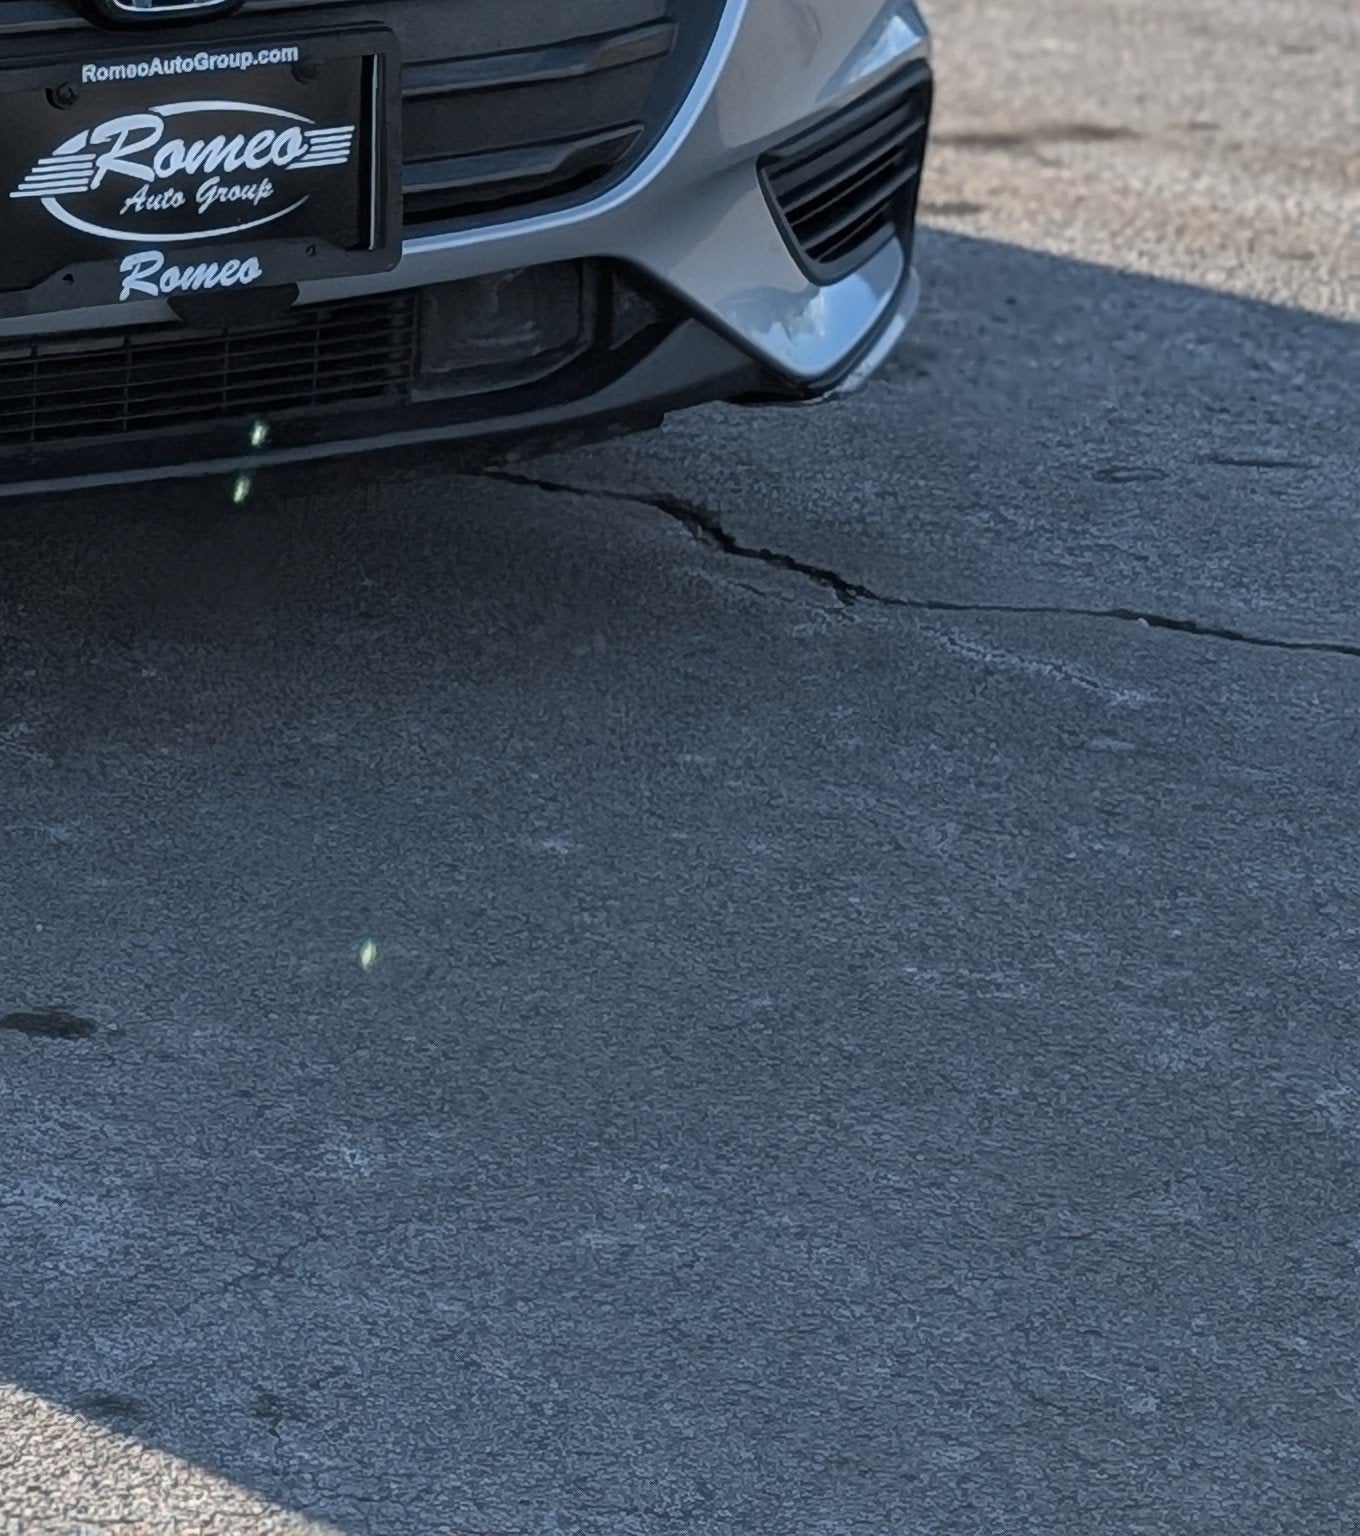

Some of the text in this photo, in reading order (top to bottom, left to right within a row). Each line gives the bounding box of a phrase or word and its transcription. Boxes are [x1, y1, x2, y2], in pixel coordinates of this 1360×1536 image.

[81, 45, 300, 83] RomeoAutoGroup.com
[89, 112, 311, 190] Romeo
[118, 175, 275, 216] Auto Group
[118, 249, 264, 302] Romeo
